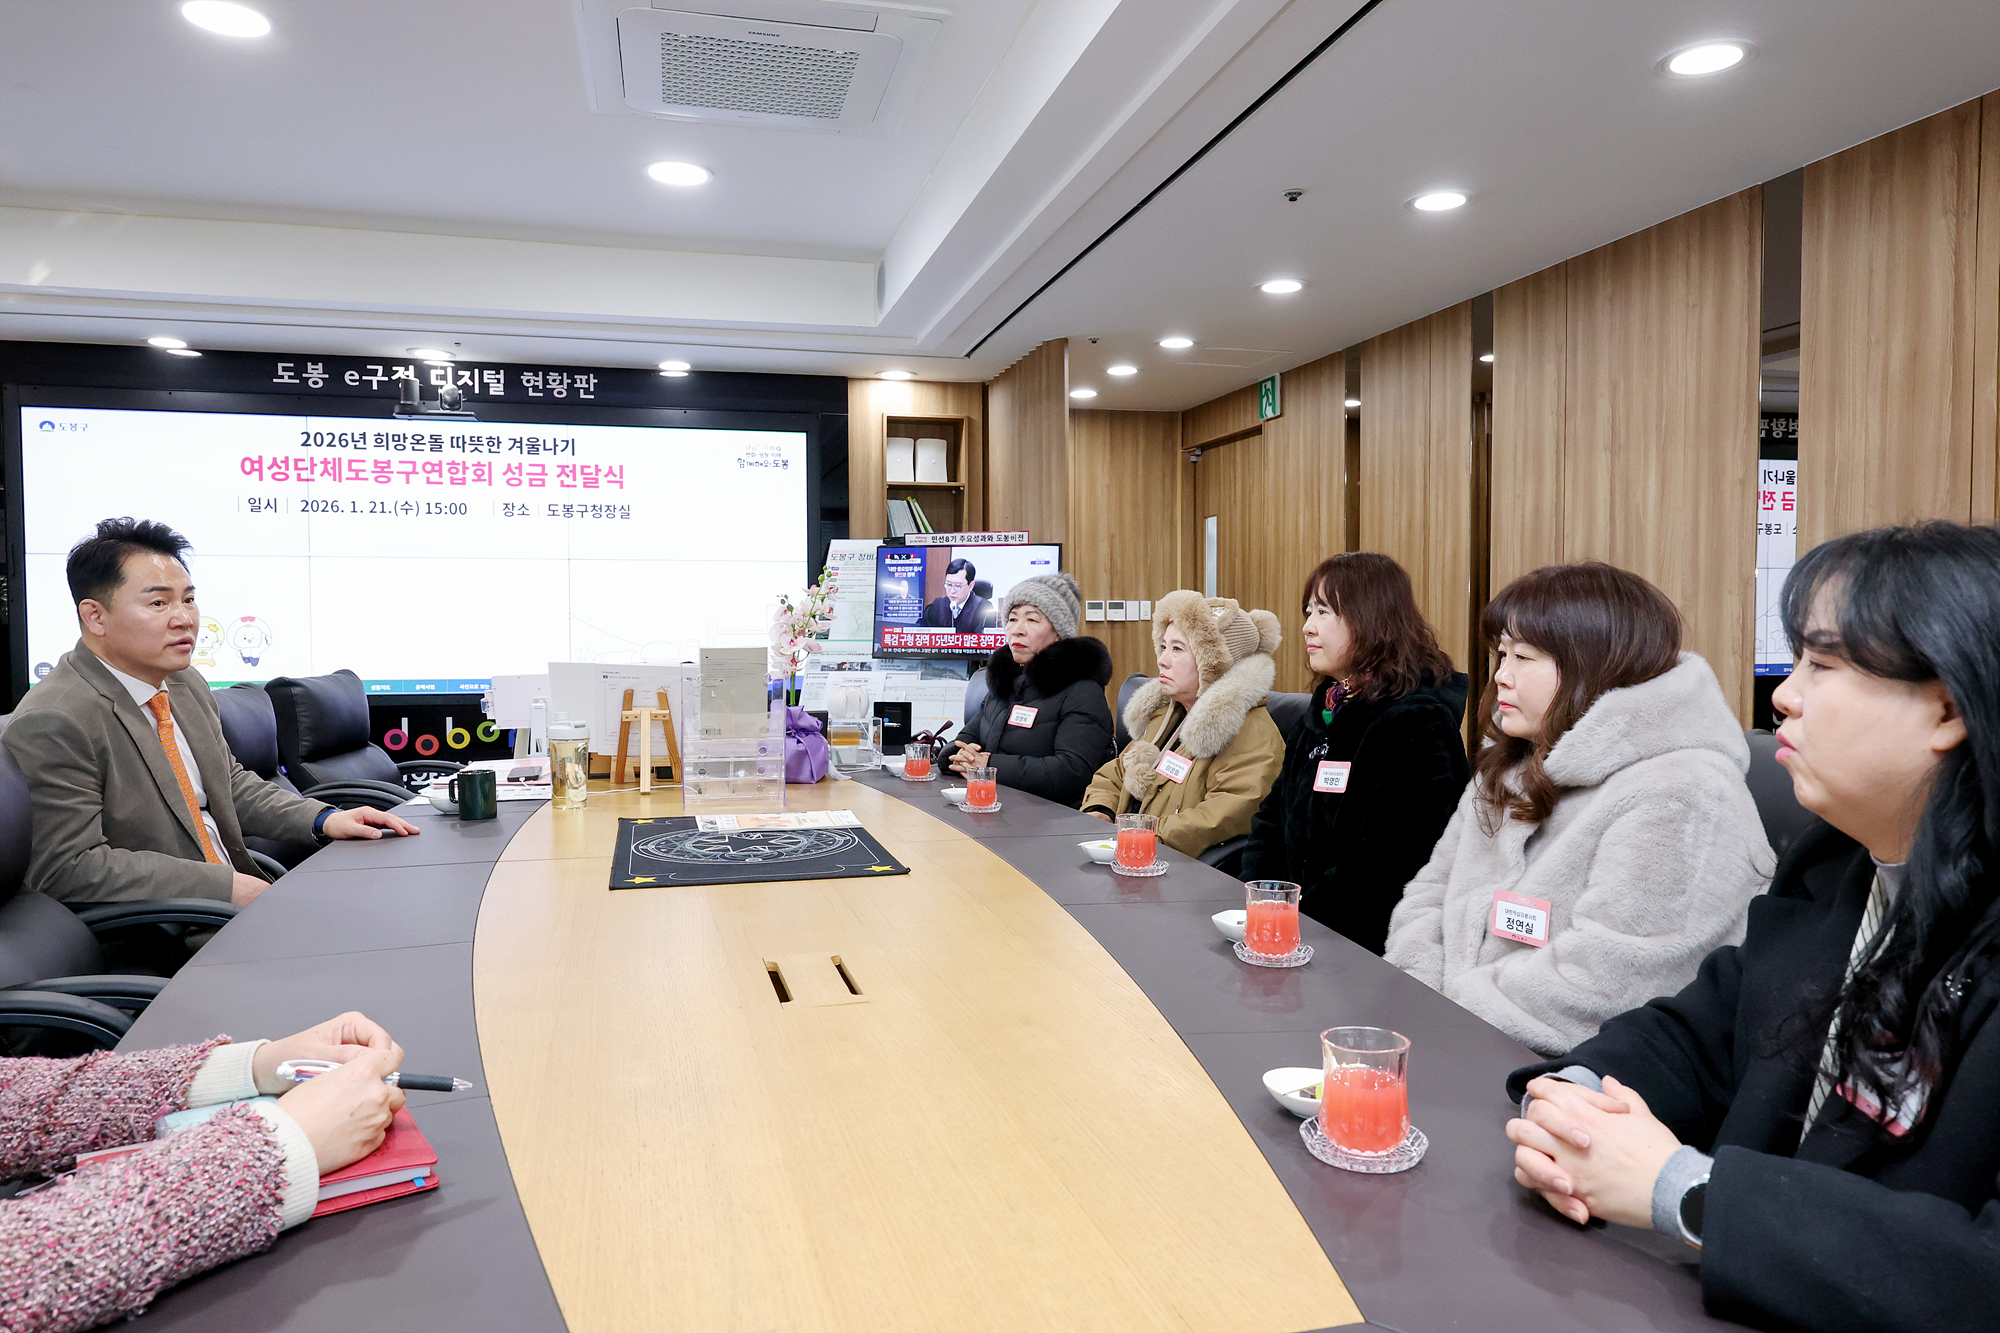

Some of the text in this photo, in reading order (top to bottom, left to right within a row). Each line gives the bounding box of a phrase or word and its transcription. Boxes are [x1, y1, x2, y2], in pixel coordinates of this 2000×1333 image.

[272, 361, 329, 389] 도봉
[430, 366, 506, 396] 디지털
[520, 370, 598, 400] 현황판
[59, 422, 88, 432] 도봉구
[300, 430, 576, 456] 2026년 희망온돌 따뜻한 겨울나기
[240, 455, 625, 490] 여성단체도봉구연합회 성금 전달식
[248, 497, 277, 513] 일시
[300, 499, 468, 517] 2026. 1. 21.(수) 15:00
[502, 502, 530, 518] 장소
[547, 503, 631, 520] 도봉구청장실
[931, 535, 957, 544] 민선8기
[959, 534, 994, 543] 주요성과와
[996, 533, 1024, 542] 도봉비전
[830, 553, 855, 561] 도봉구
[884, 633, 1008, 647] 특검 구형 징역 15년보다 많은 징역 23
[1505, 916, 1534, 935] 정연실
